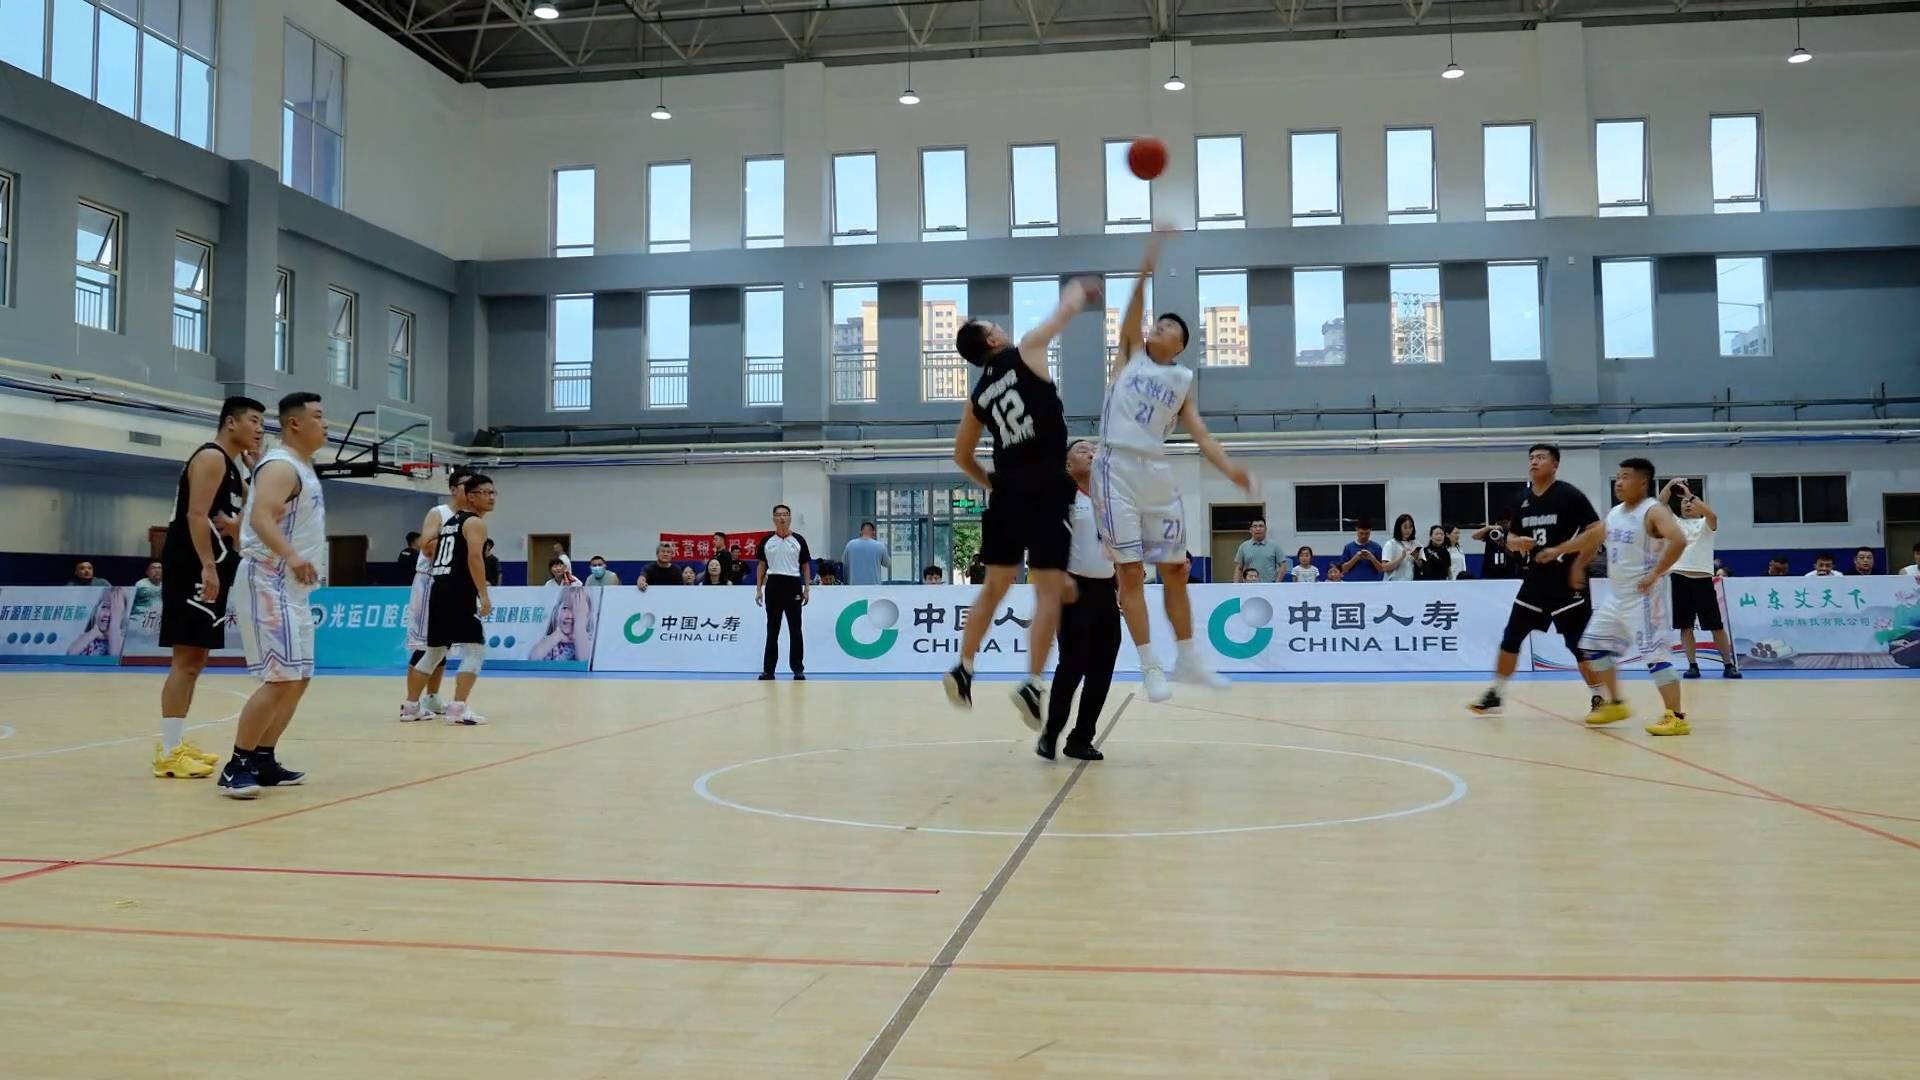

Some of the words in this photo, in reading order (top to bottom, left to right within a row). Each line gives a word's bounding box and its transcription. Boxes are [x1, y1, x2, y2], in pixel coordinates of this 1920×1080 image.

[992, 388, 1033, 438] 12
[1134, 401, 1155, 425] 21
[1162, 518, 1181, 540] 21
[433, 535, 456, 567] 10
[1739, 588, 1867, 610] 山东艾天下
[661, 615, 742, 632] 中国人寿
[1288, 601, 1460, 632] 中国人寿
[659, 632, 702, 642] CHINA
[708, 633, 738, 642] LIFE
[913, 638, 1002, 653] CHIA
[1288, 636, 1383, 652] CHINA
[1395, 636, 1459, 651] LIFE
